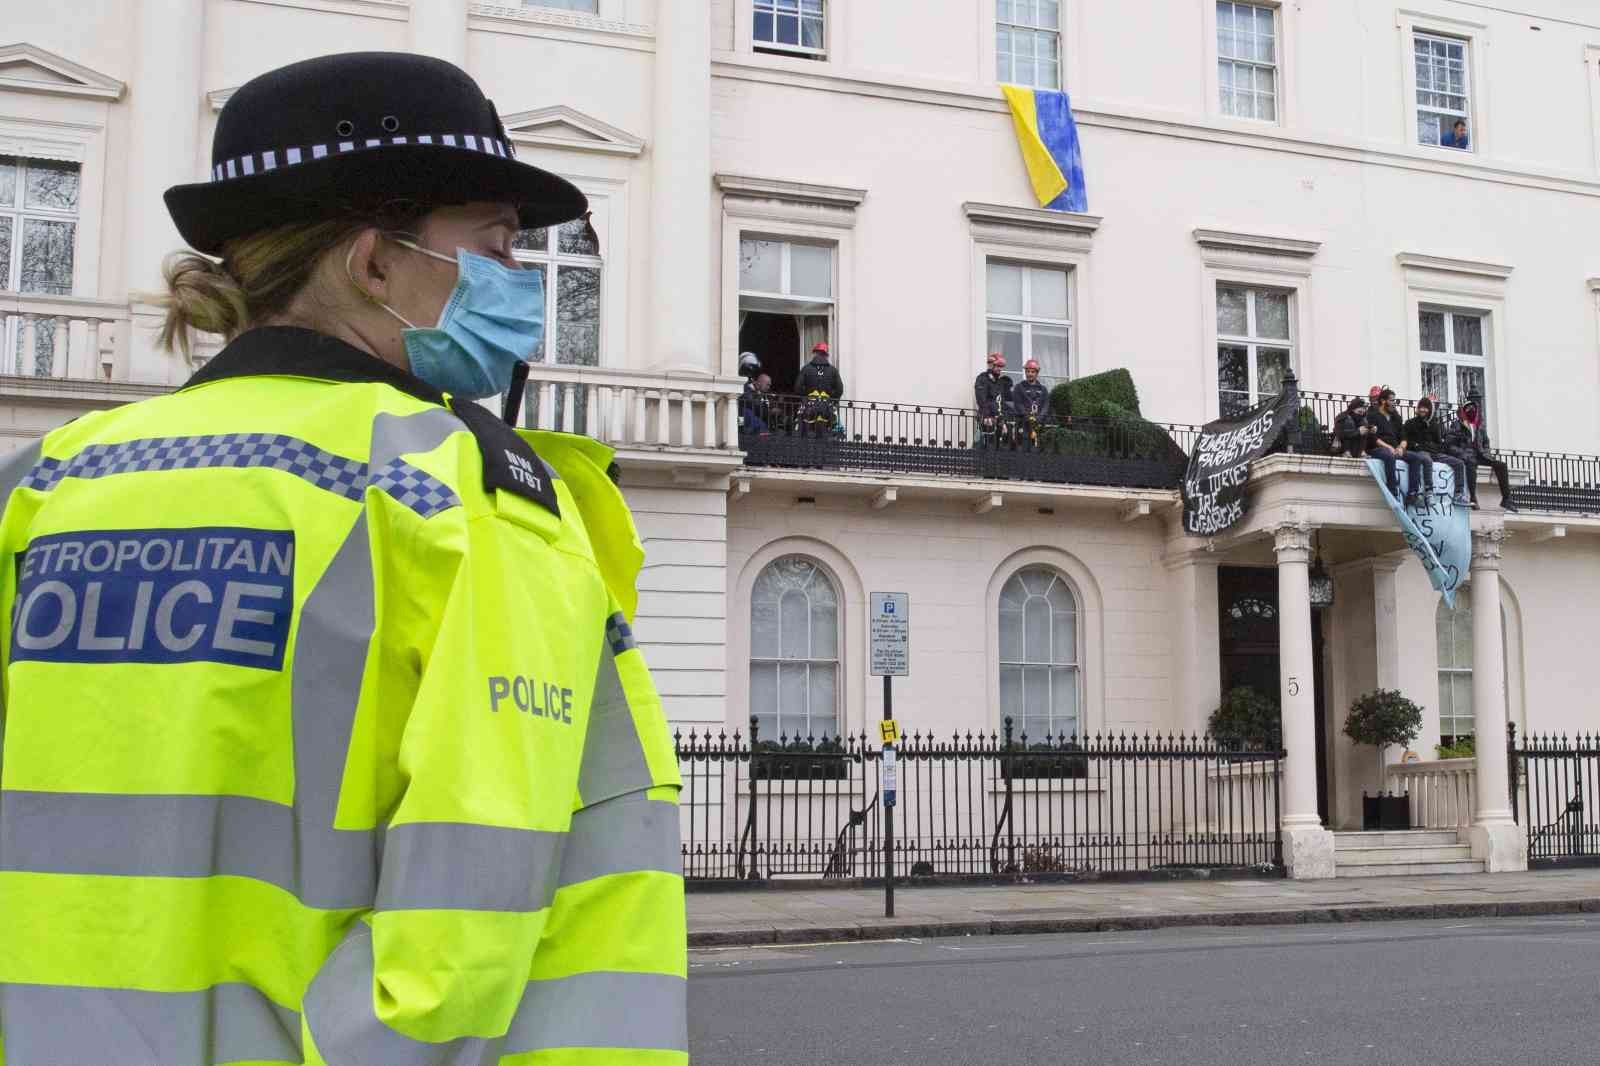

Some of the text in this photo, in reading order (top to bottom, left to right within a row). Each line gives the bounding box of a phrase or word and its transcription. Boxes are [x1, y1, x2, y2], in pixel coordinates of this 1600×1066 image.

[20, 537, 294, 580] ETROPOLITAN
[488, 675, 573, 725] POLICE
[1288, 677, 1300, 697] 5
